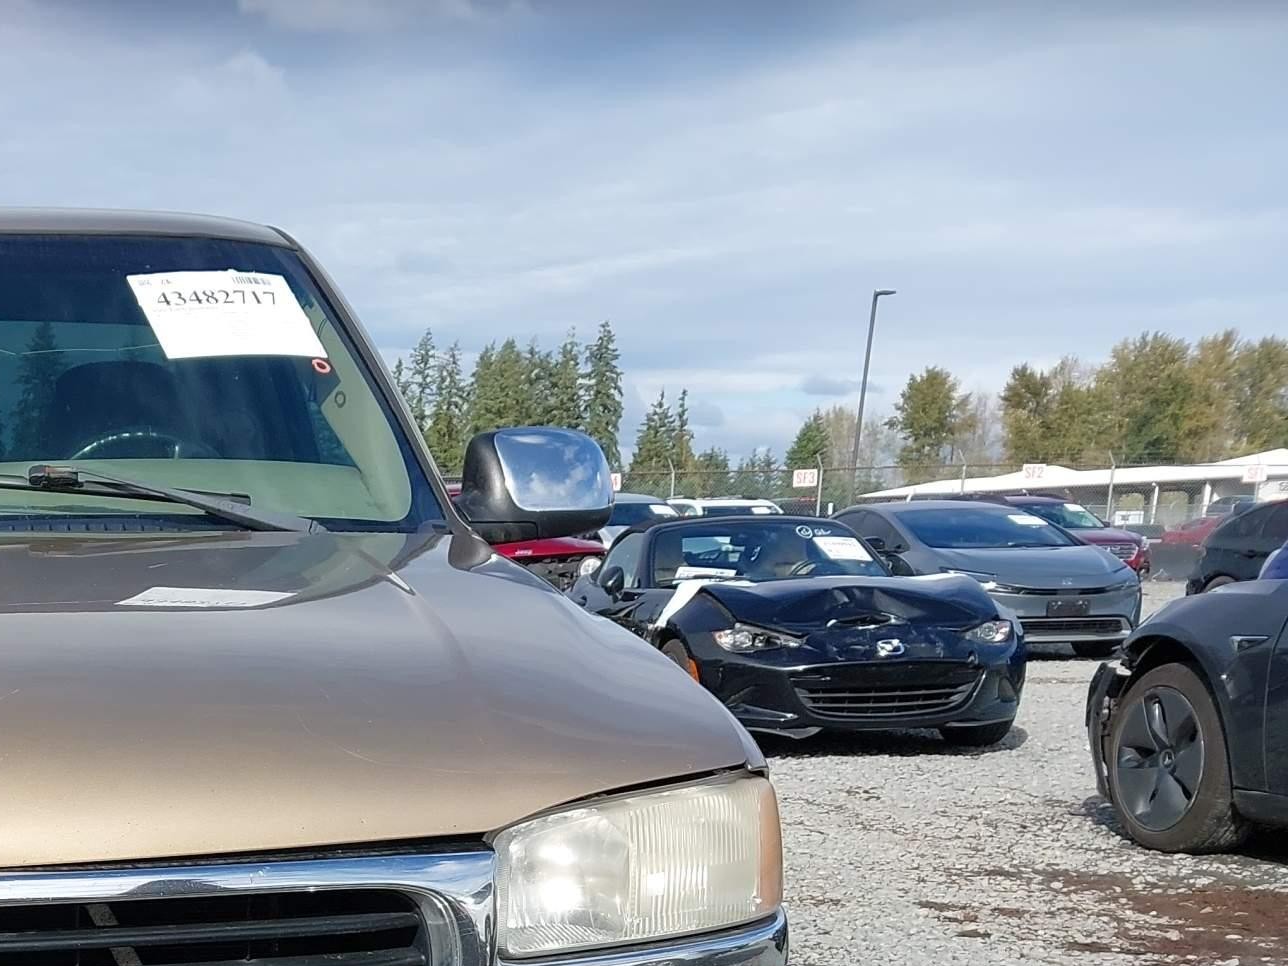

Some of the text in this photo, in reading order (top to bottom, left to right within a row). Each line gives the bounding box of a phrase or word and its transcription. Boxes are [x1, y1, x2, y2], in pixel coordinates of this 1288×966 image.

[157, 289, 276, 306] 43482717
[796, 471, 815, 485] SF3
[1024, 465, 1044, 479] SF2
